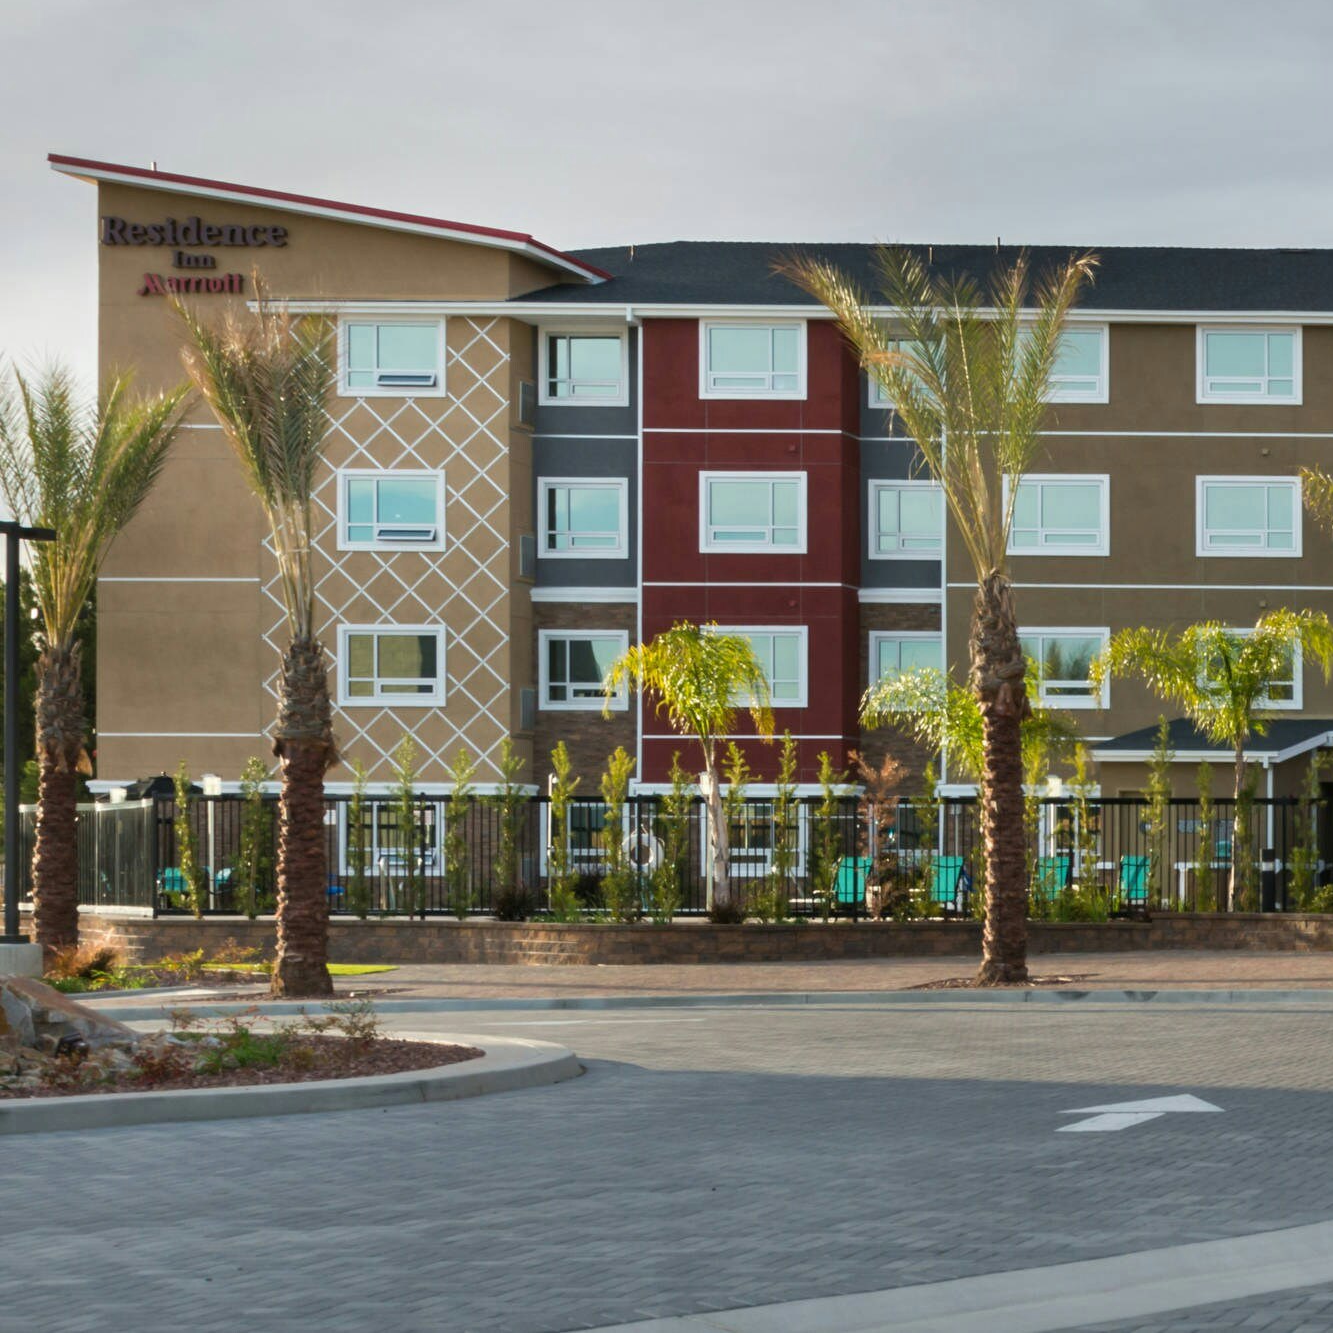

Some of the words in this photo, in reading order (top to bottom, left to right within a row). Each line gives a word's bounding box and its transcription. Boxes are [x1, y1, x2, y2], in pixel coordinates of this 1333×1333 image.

[102, 216, 289, 247] Residence
[172, 249, 217, 269] Inn
[137, 272, 244, 297] Marriott
